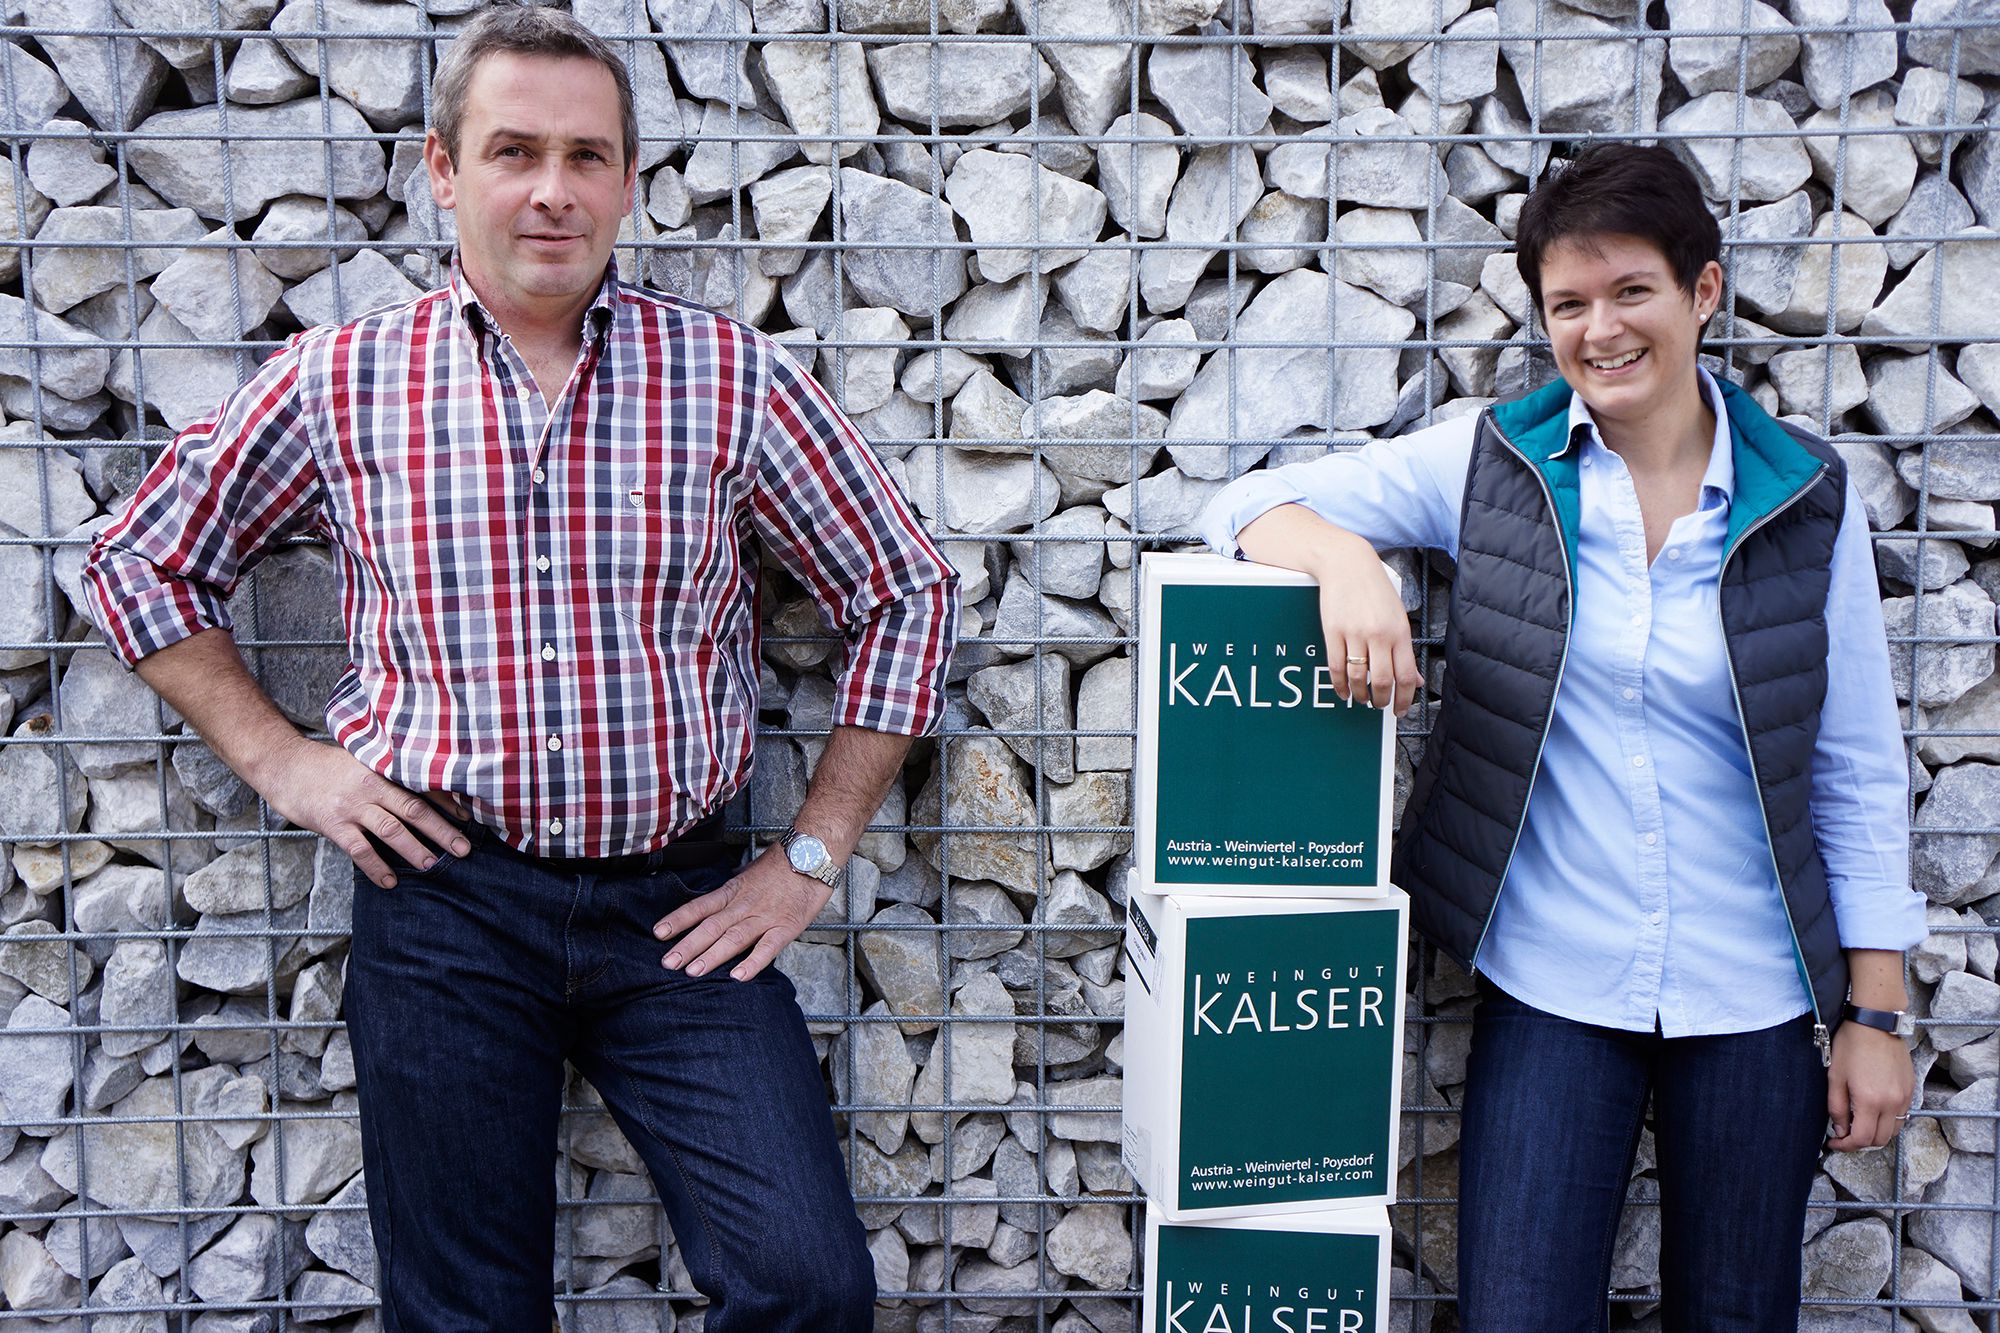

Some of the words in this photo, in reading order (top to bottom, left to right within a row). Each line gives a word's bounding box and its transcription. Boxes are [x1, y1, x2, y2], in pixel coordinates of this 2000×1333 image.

[1192, 643, 1317, 657] WEING
[1168, 642, 1375, 709] KALSE
[1166, 839, 1212, 853] Austria
[1224, 840, 1296, 854] Weinviertel
[1308, 841, 1364, 857] Poysdorf
[1167, 854, 1363, 869] www.weingut-kalser.com
[1216, 965, 1384, 985] WEINGUT
[1193, 974, 1385, 1036] KALSER
[1190, 1161, 1233, 1178] Austria
[1245, 1157, 1311, 1174] Weinviertel
[1322, 1153, 1374, 1171] Poysdorf
[1191, 1170, 1373, 1191] www.weingut-kalser.com
[1188, 1281, 1365, 1301] WEINGUT
